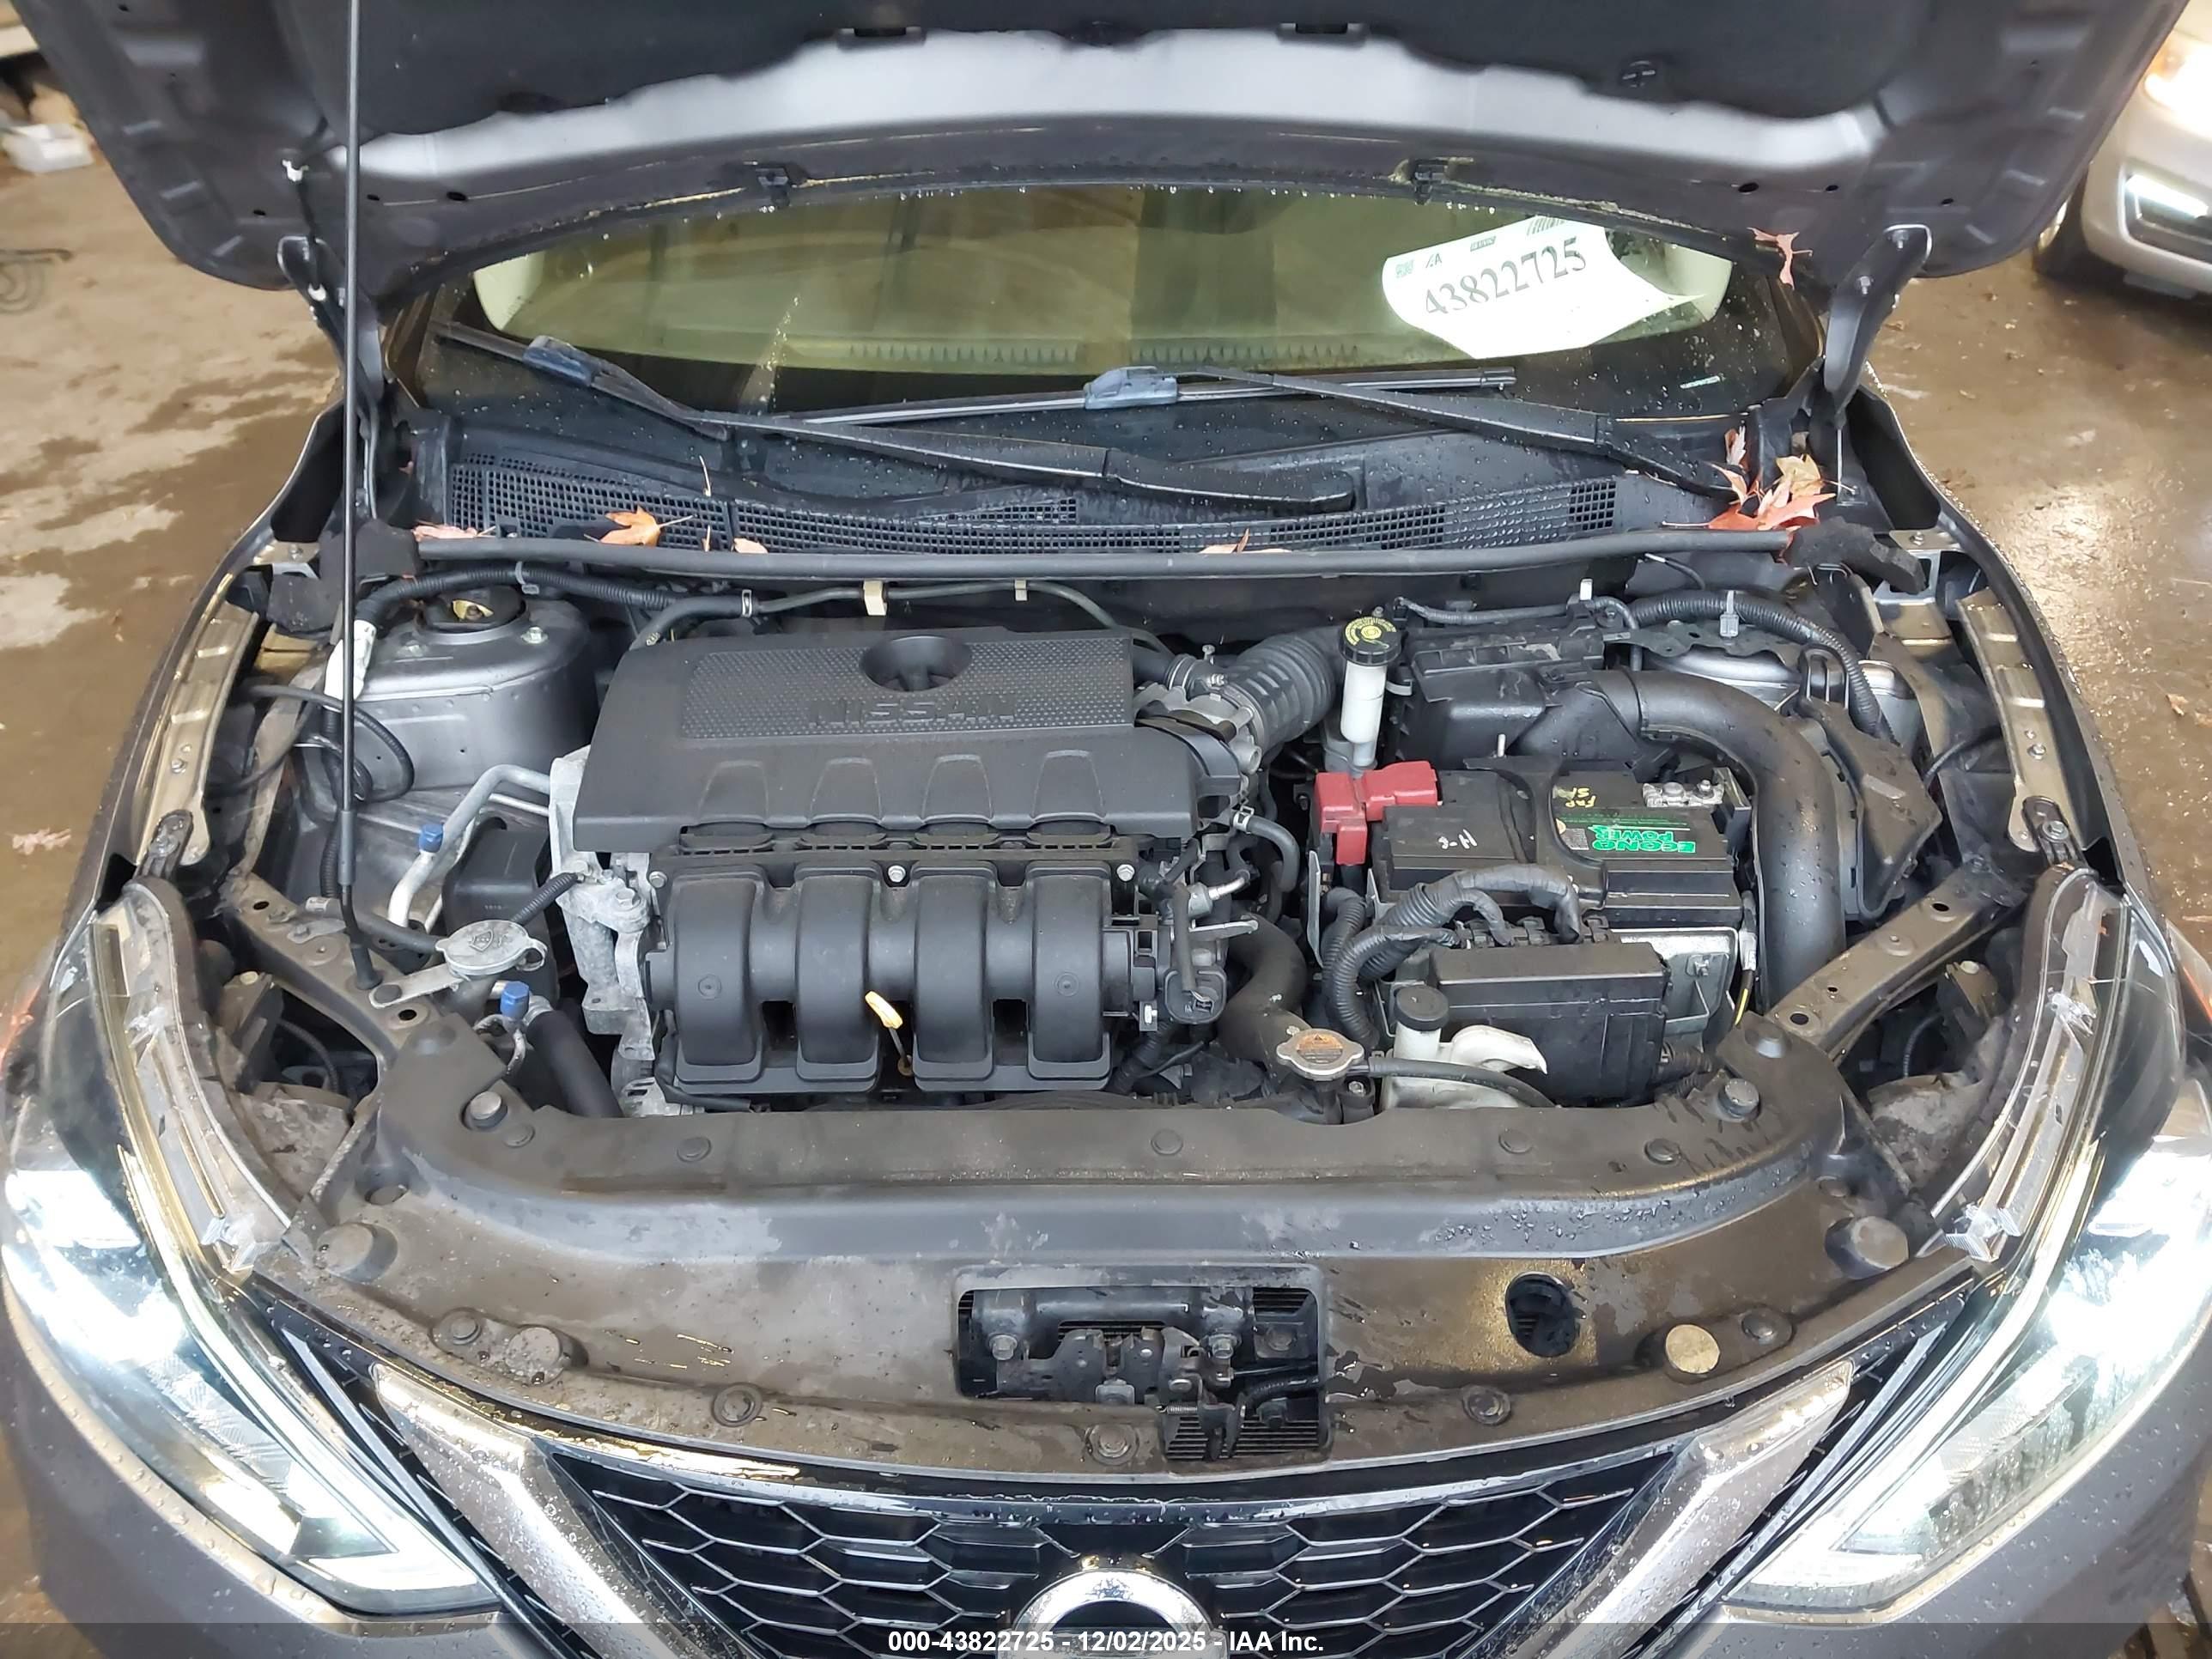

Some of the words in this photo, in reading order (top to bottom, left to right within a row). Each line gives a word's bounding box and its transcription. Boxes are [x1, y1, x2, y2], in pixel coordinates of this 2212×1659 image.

[1425, 236, 1586, 314] 43822725
[807, 694, 1015, 728] NISSAN
[1591, 826, 1674, 843] POWER
[1592, 839, 1696, 854] ECONO
